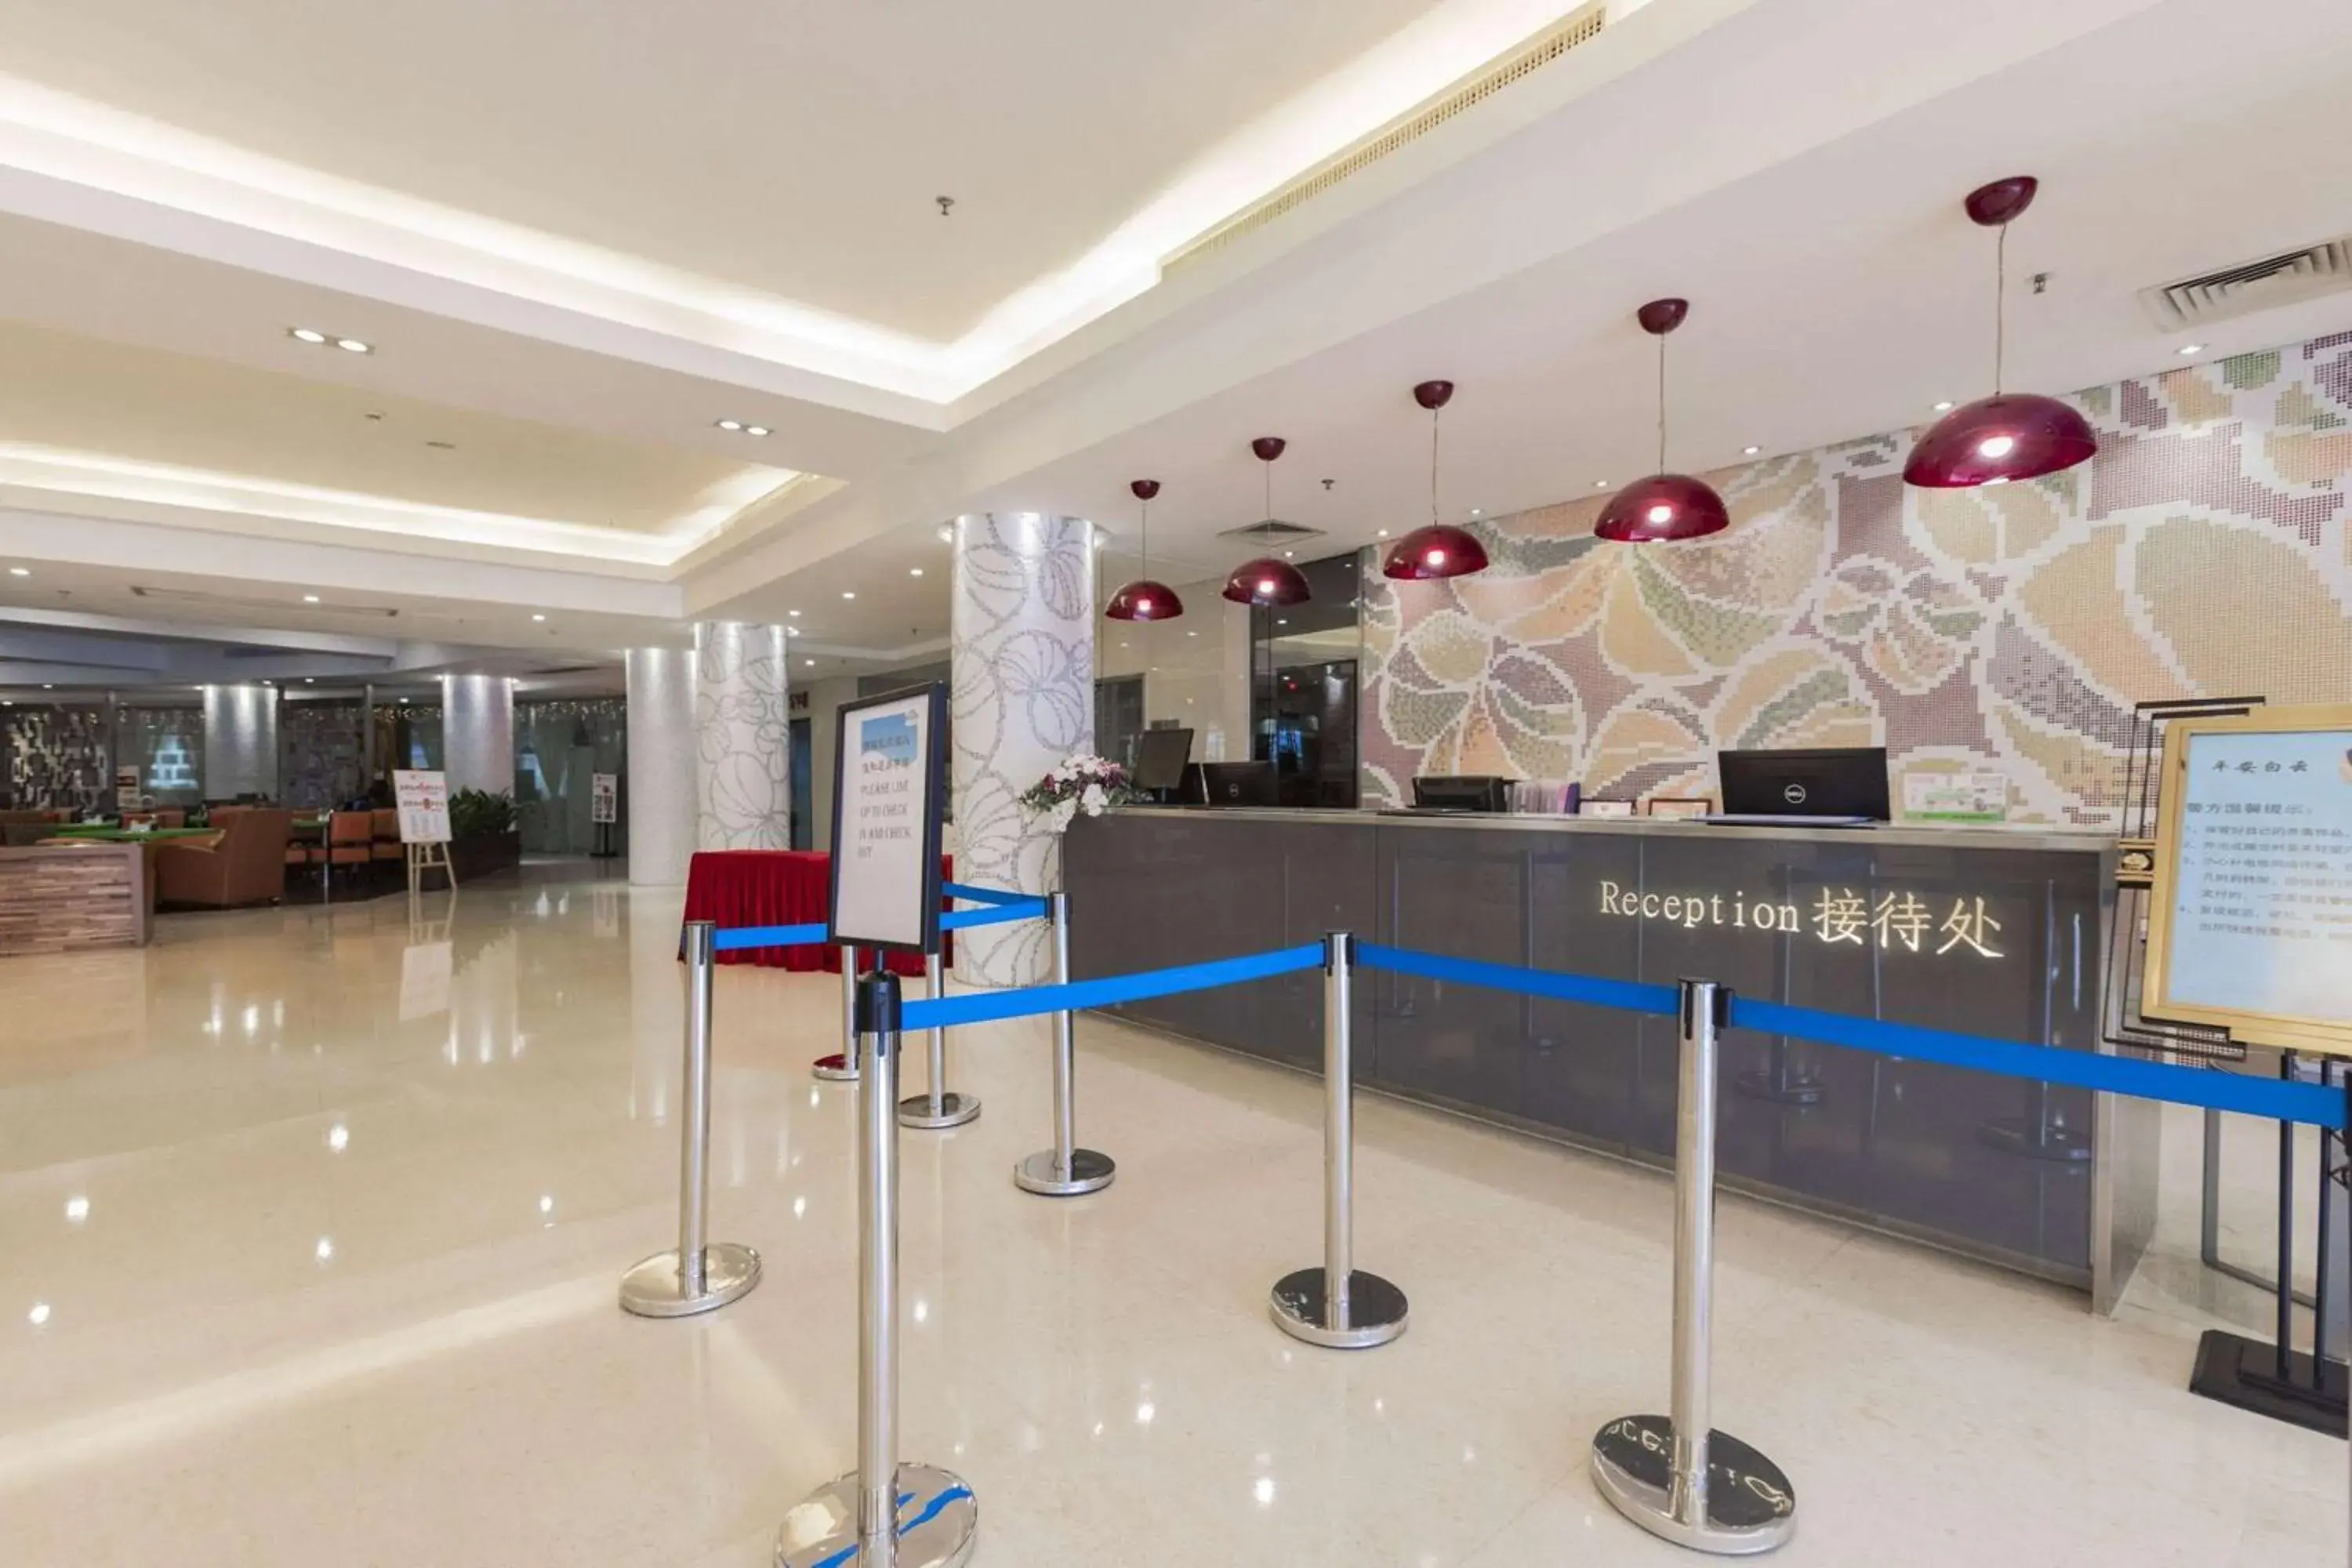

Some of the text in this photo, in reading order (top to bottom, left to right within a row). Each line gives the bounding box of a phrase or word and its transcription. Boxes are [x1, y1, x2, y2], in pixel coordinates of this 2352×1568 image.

[2212, 760, 2309, 774] 平安白云
[1599, 880, 2005, 958] Reception 接待处
